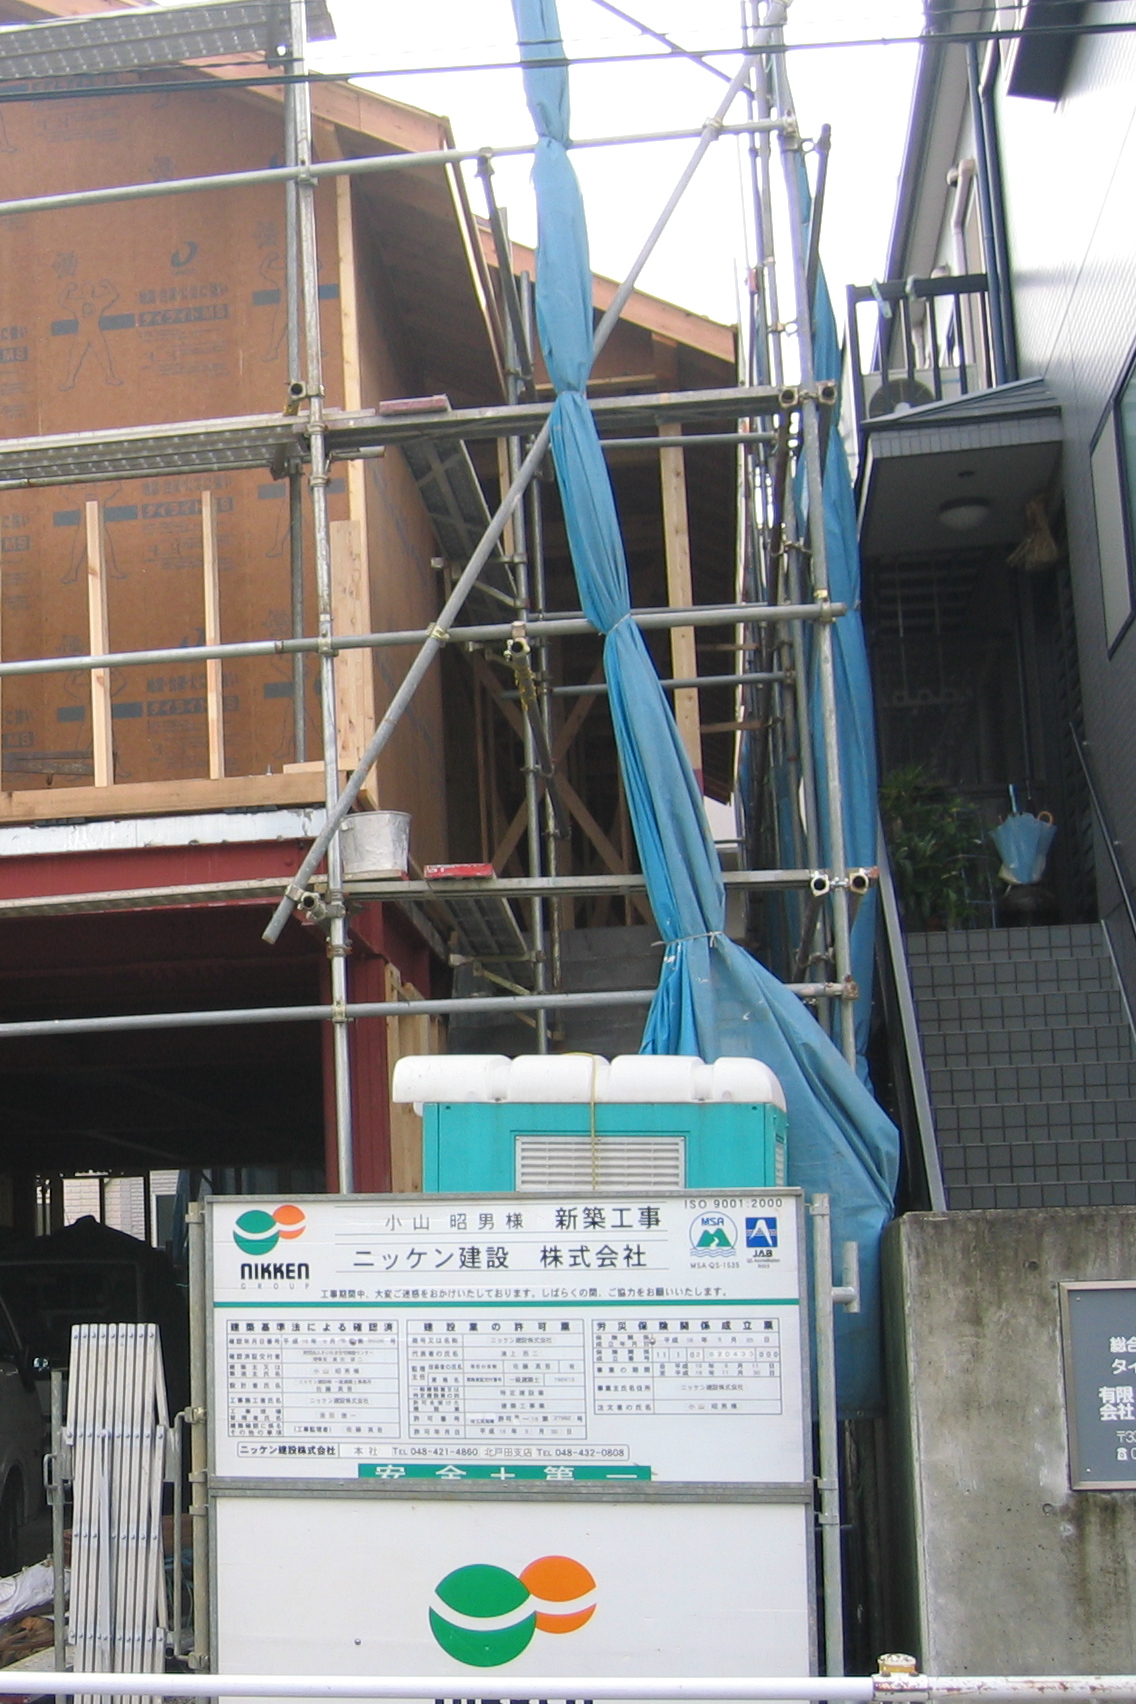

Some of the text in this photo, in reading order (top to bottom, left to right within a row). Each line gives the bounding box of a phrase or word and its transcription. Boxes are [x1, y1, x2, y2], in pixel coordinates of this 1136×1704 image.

[684, 1198, 783, 1209] ISO 9001:2000
[555, 1206, 661, 1230] 新築工事
[701, 1217, 725, 1226] MSA
[539, 1243, 648, 1269] 株式会社
[752, 1249, 773, 1258] JAB
[240, 1262, 310, 1280] NIKKEN
